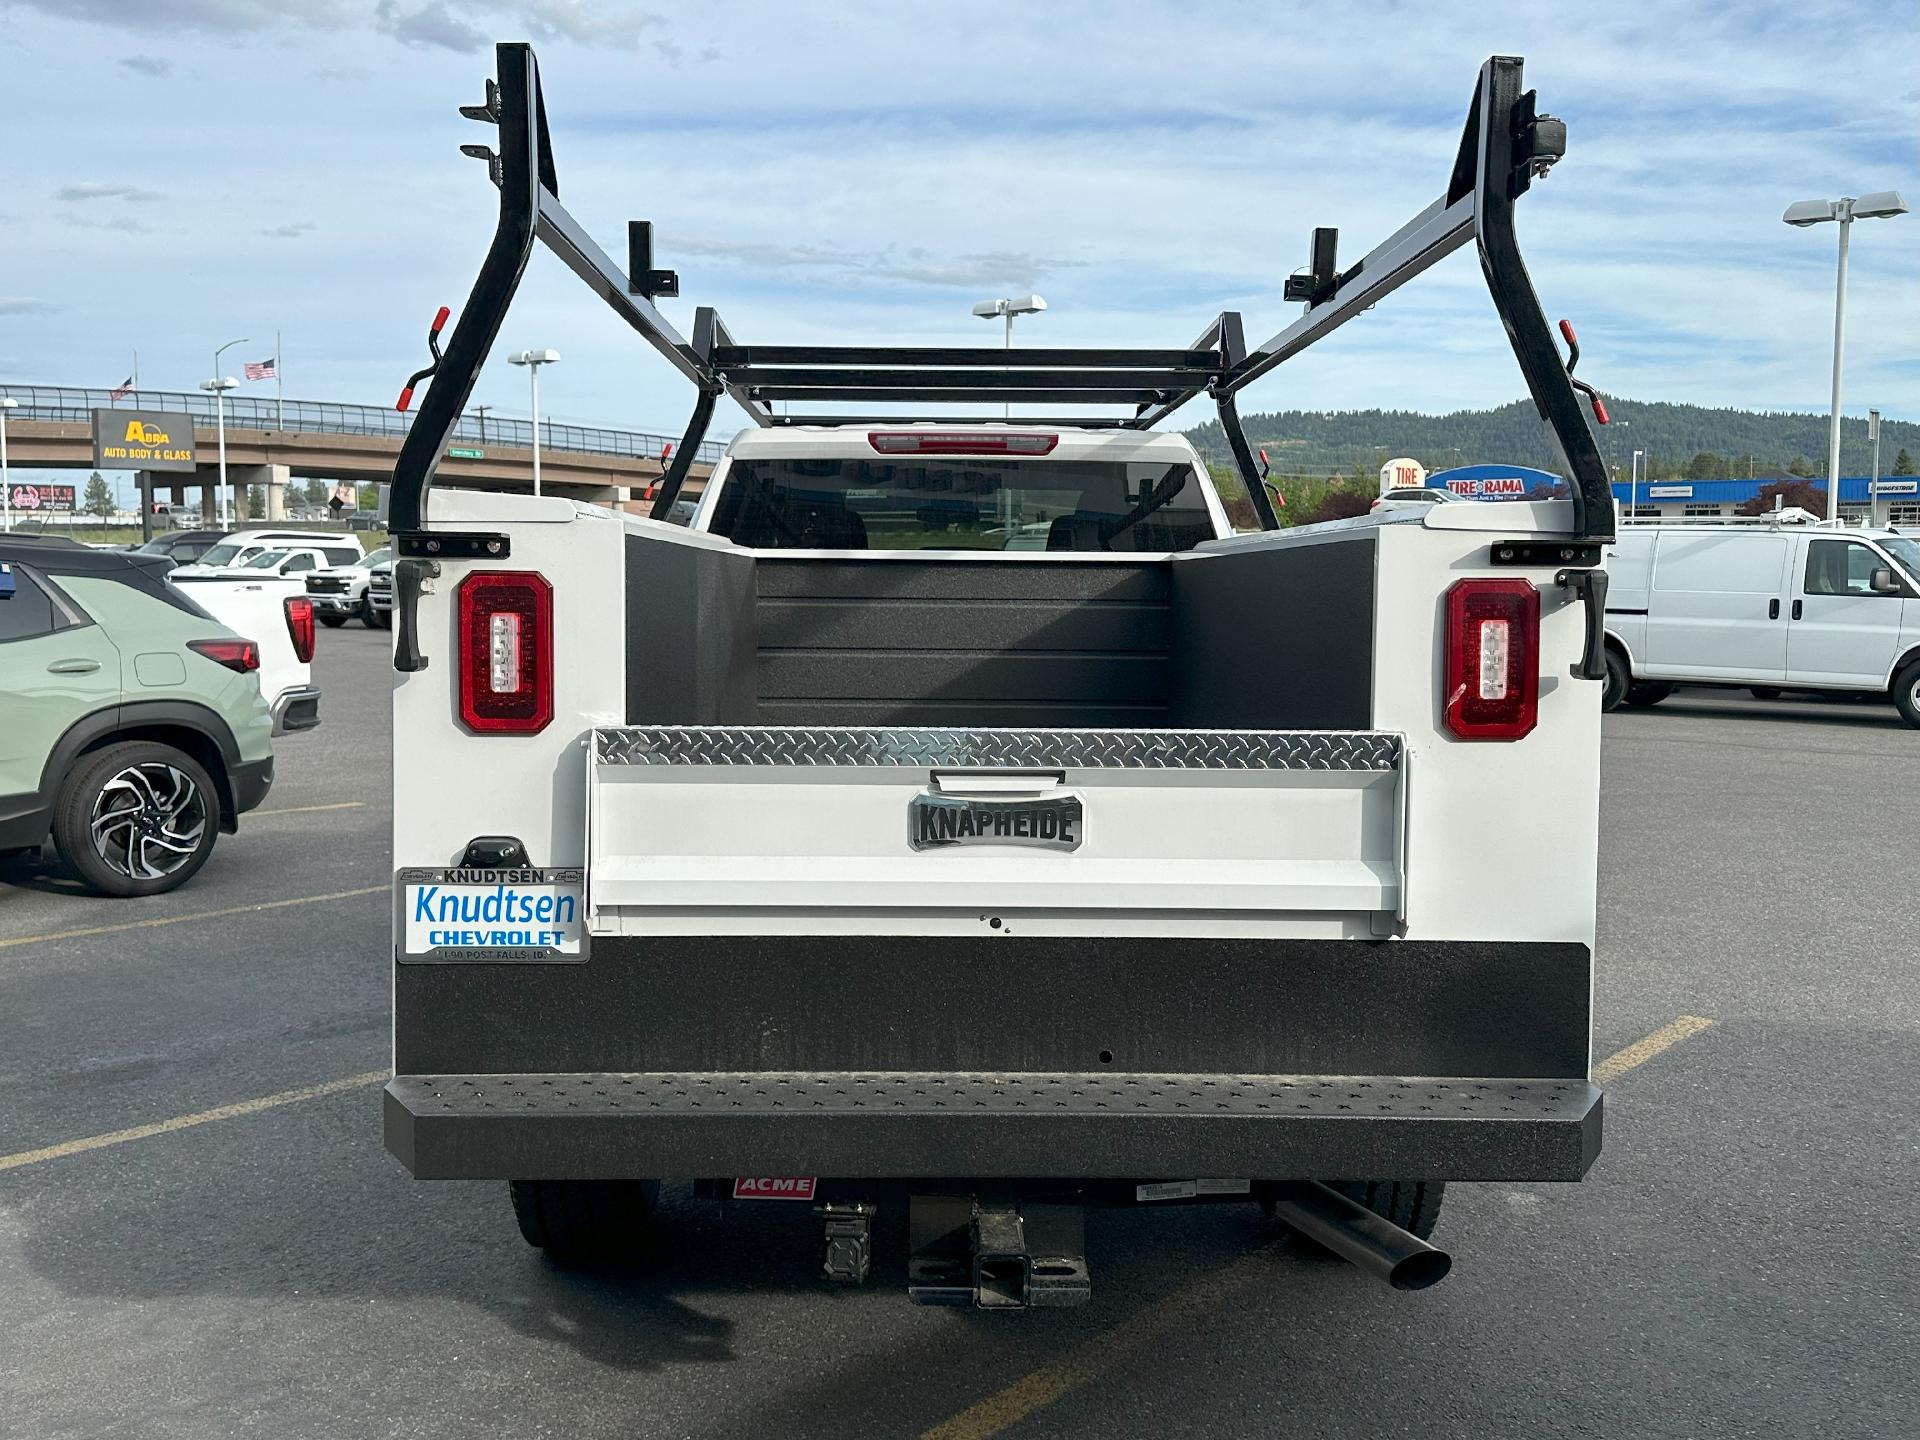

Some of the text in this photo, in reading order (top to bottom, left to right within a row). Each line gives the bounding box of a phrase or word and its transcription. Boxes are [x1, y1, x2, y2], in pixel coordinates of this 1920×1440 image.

[125, 421, 170, 444] ABRA
[104, 447, 191, 461] AUTO BODY & GLASS
[1396, 466, 1418, 485] TIRE
[1447, 479, 1523, 494] TIRE RAMA
[920, 803, 1074, 843] KNAPHEIDE
[444, 869, 545, 884] KNUDTSEN
[415, 885, 575, 923] Knudtsen
[429, 931, 565, 946] CHEVROLET
[467, 951, 493, 959] POST
[740, 1178, 811, 1191] ACME
